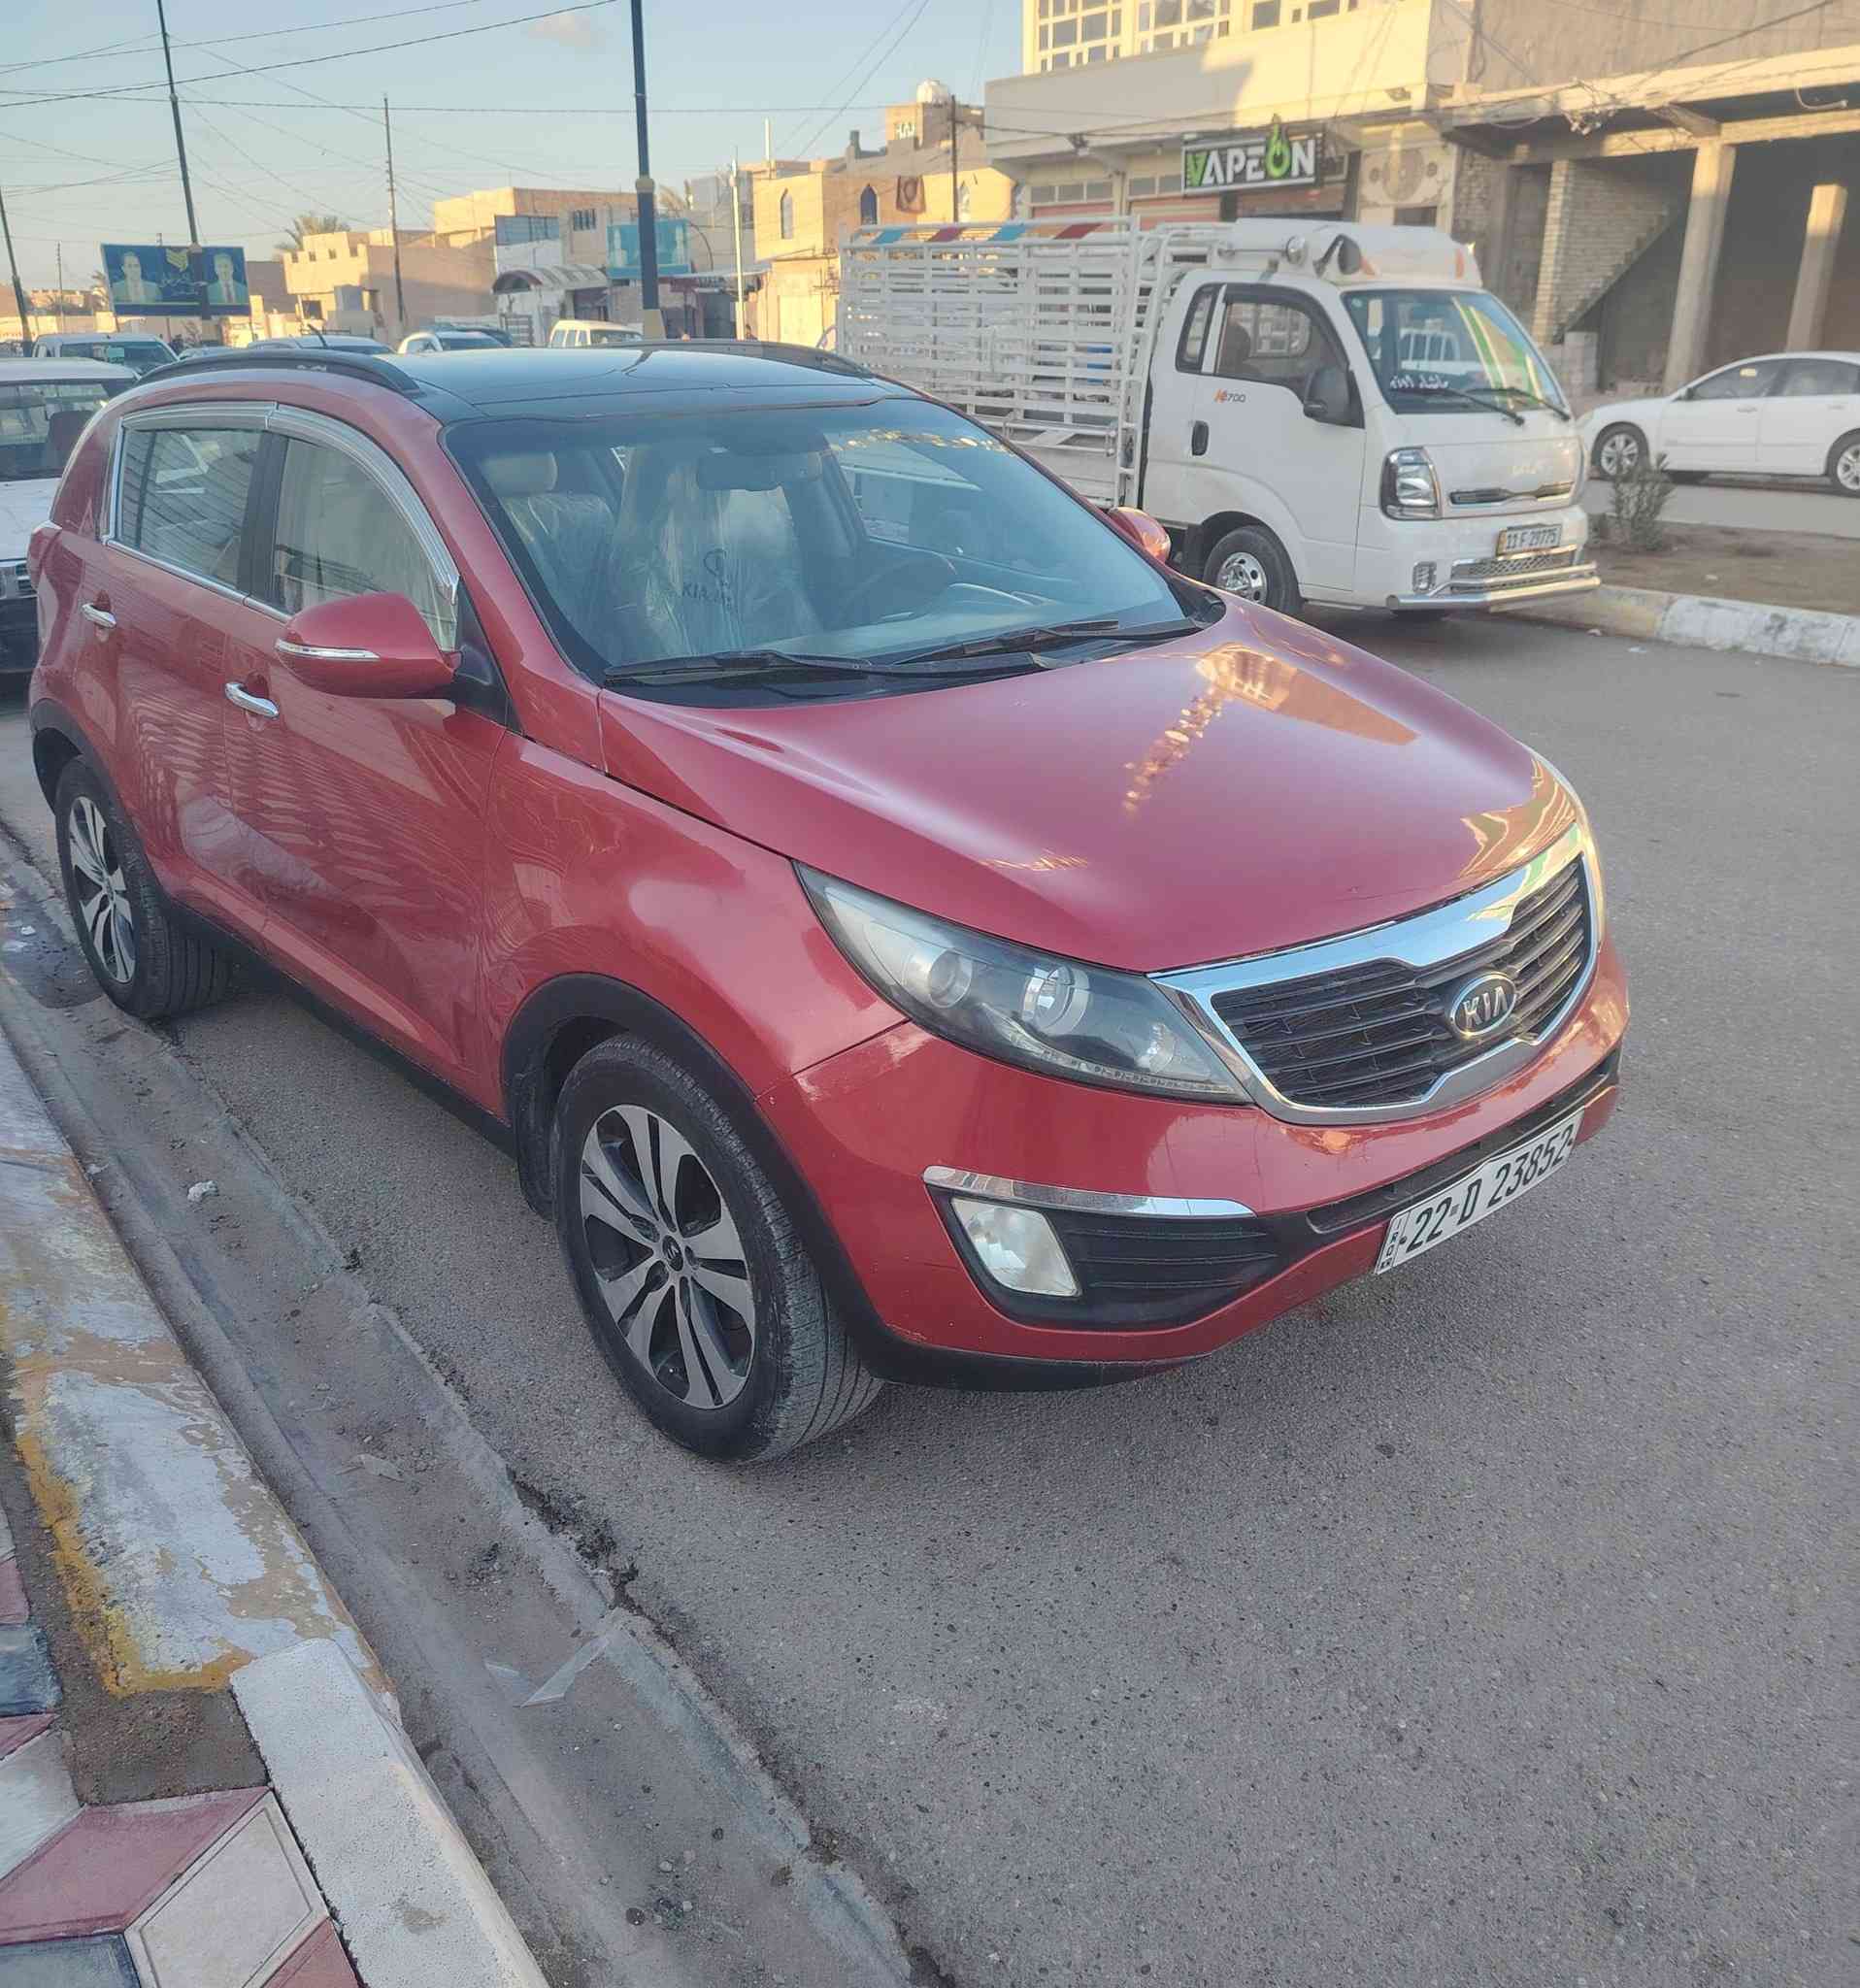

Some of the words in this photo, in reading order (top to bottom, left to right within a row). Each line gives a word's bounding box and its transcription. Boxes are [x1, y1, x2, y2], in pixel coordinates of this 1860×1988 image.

[1186, 126, 1315, 187] VAPEON
[1463, 985, 1509, 1028] KIA
[1406, 1197, 1452, 1253] 22
[1456, 1177, 1483, 1225] D
[1487, 1123, 1575, 1209] 23852
